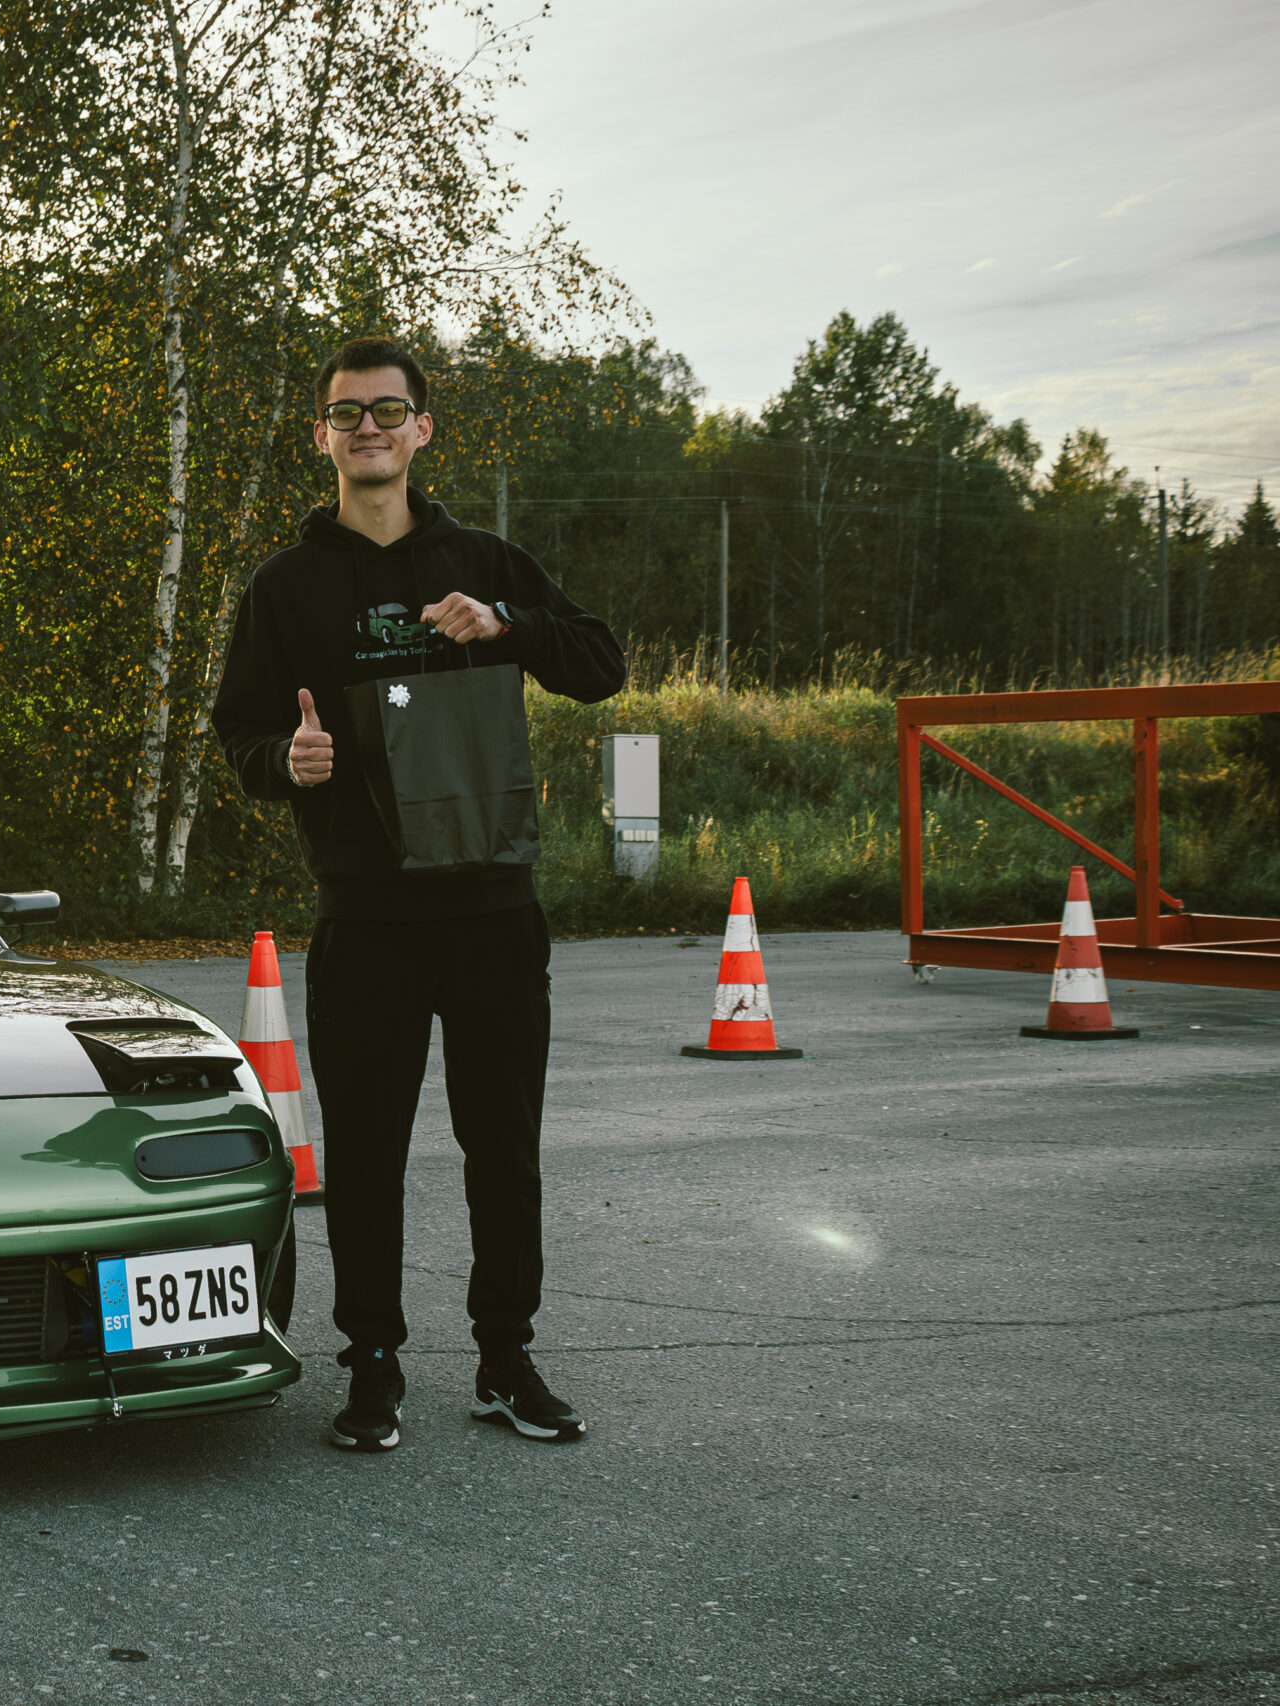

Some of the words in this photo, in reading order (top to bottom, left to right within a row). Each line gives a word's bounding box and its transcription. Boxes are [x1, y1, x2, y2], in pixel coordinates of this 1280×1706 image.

[355, 651, 368, 660] Car
[399, 648, 408, 656] by
[104, 1314, 129, 1331] EST
[135, 1273, 180, 1327] 58
[184, 1265, 250, 1322] ZNS
[163, 1343, 207, 1360] マツダ
